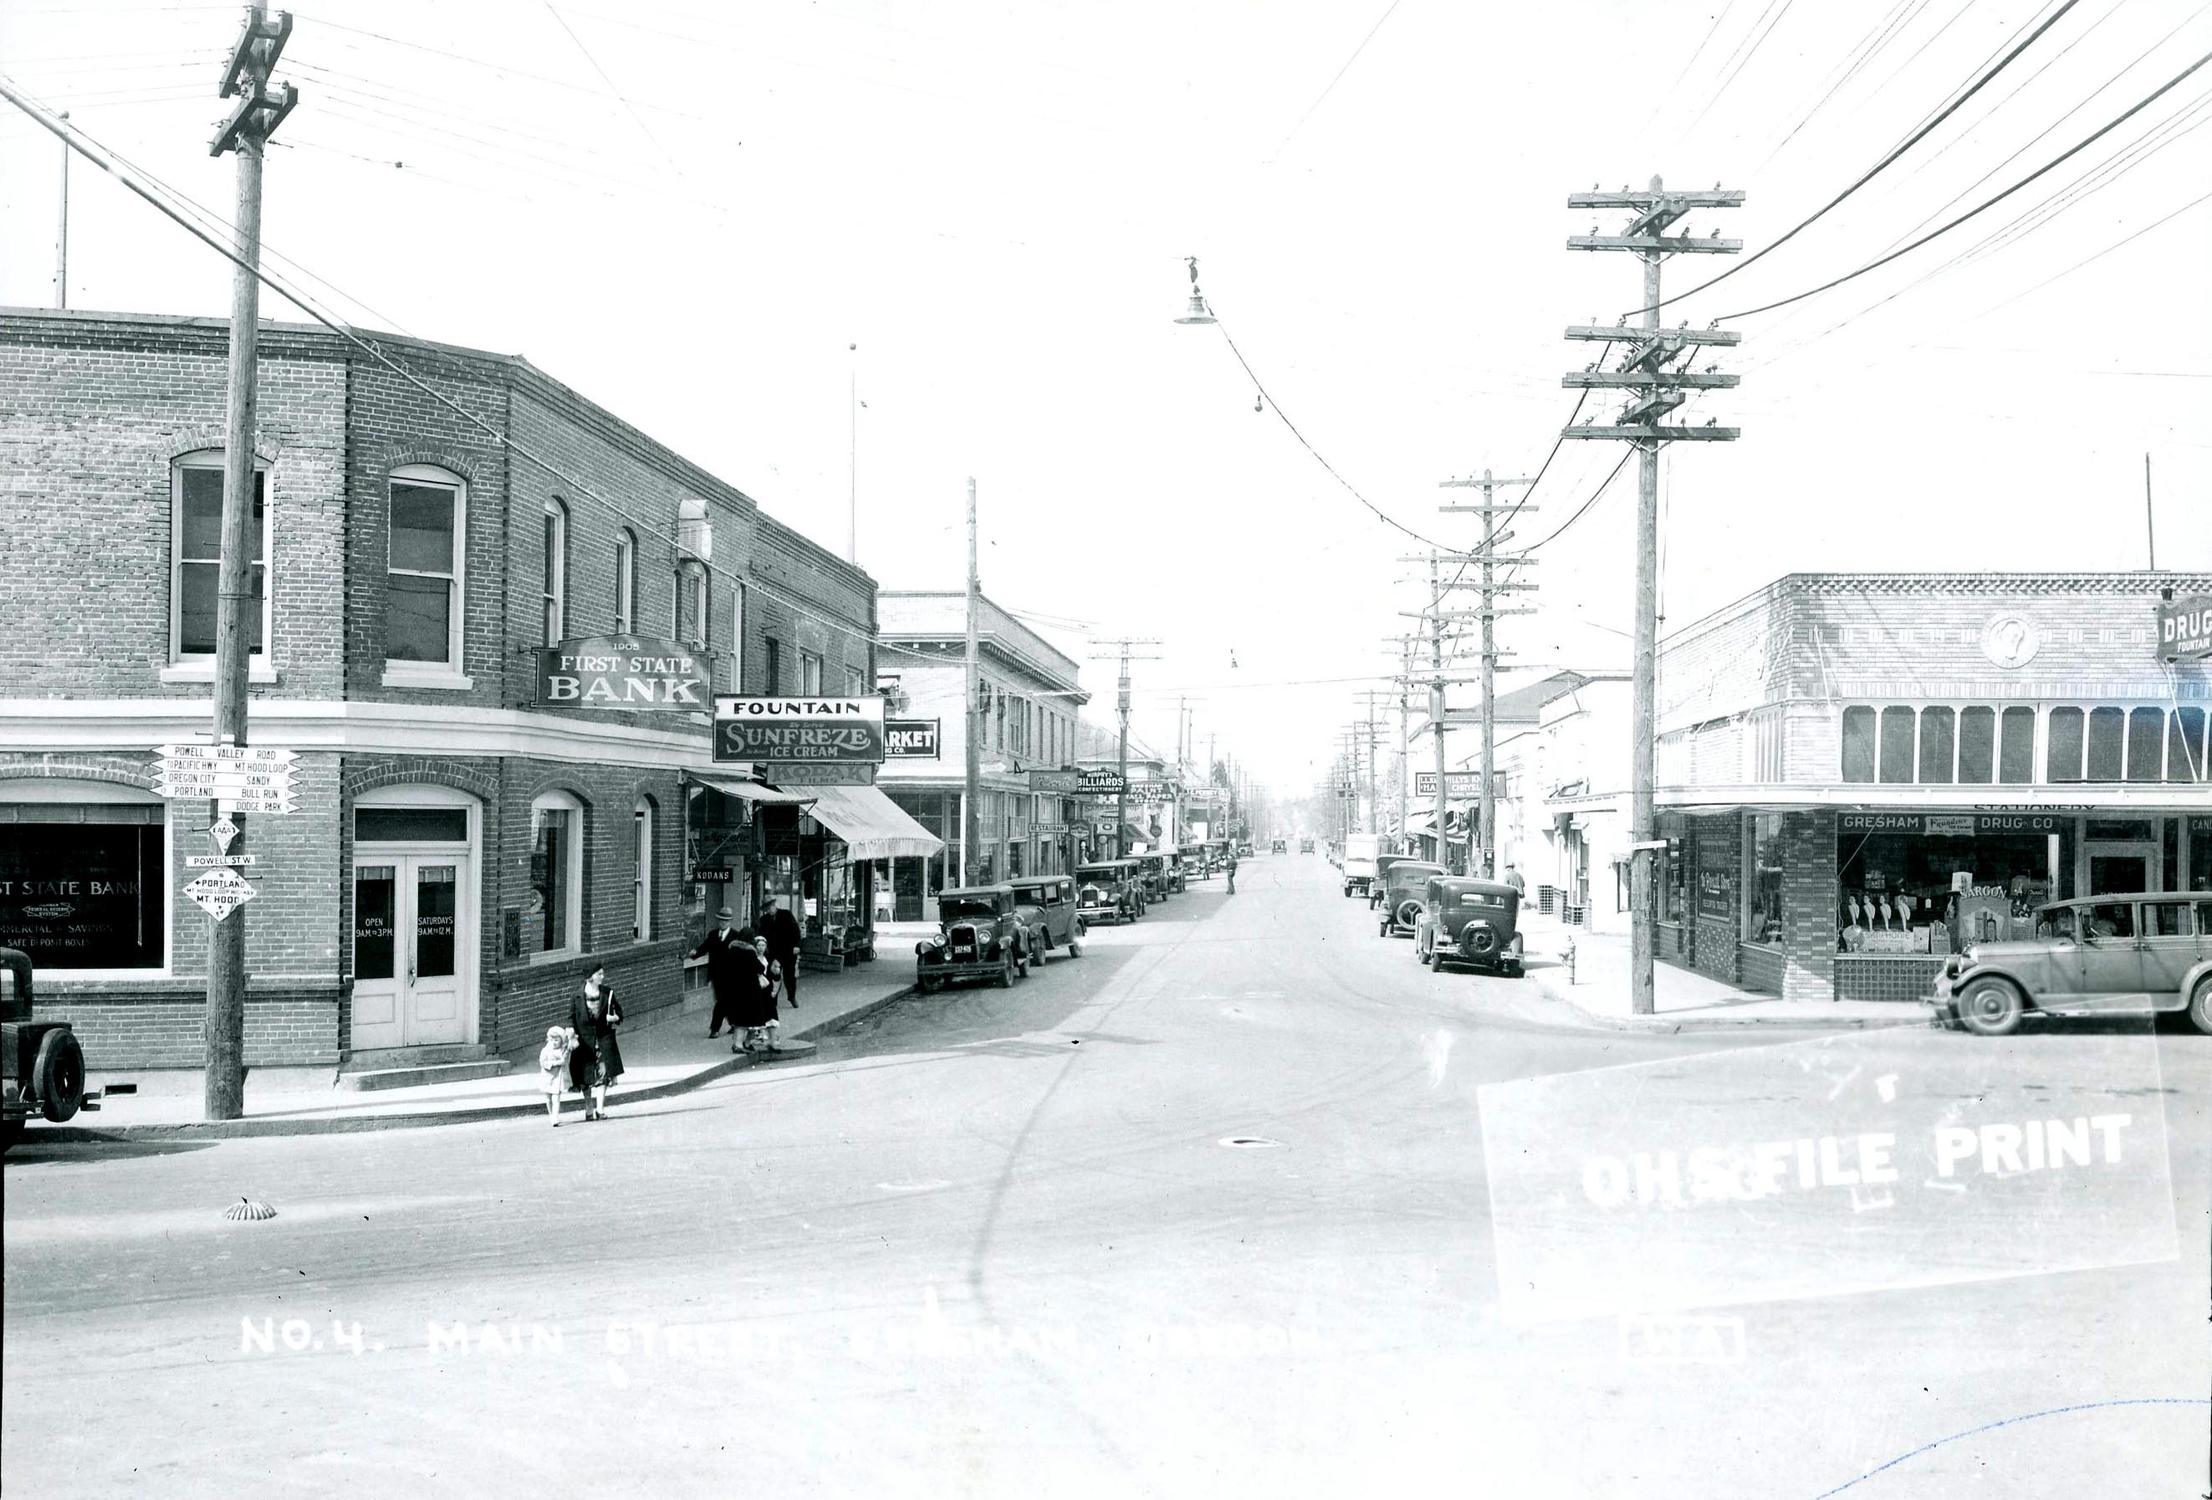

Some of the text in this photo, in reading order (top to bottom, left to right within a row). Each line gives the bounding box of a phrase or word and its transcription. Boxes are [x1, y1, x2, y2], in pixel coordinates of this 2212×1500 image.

[2164, 609, 2212, 643] DRUG
[2177, 637, 2210, 653] FOUNTAIN
[560, 655, 692, 674] FIRST STATE
[547, 675, 701, 704] BANK
[733, 702, 861, 715] FOUNTAIN
[726, 723, 871, 754] SUNFREZE
[174, 747, 276, 760] POWELL VALLEY ROAD
[759, 746, 791, 757] ICE
[793, 746, 839, 757] CREAM
[173, 760, 201, 770] PACIFIC
[201, 761, 218, 771] HWY
[235, 762, 246, 772] MT
[247, 763, 268, 773] HOOD
[268, 763, 289, 774] LOOP
[168, 773, 198, 783] OREGON
[199, 774, 217, 784] CITY
[246, 776, 270, 786] SANDY
[773, 765, 866, 783] KODAK
[1077, 777, 1124, 787] BILLIARDS
[174, 786, 214, 796] PORTLAND
[241, 789, 259, 799] BULL
[263, 790, 279, 800] RUN
[236, 801, 260, 812] DODGE
[264, 803, 282, 812] PARK
[1844, 815, 1919, 829] GRESHAM
[1981, 817, 2023, 829] DRUG
[2032, 817, 2053, 829] CO
[193, 857, 228, 865] POWELL
[231, 856, 241, 864] ST
[696, 871, 729, 880] KODAKS
[22, 881, 80, 895] STATE
[90, 881, 139, 895] BANK
[201, 879, 246, 889] PORTLAND
[365, 918, 384, 927] OPEN
[418, 916, 453, 926] SATURDAYS
